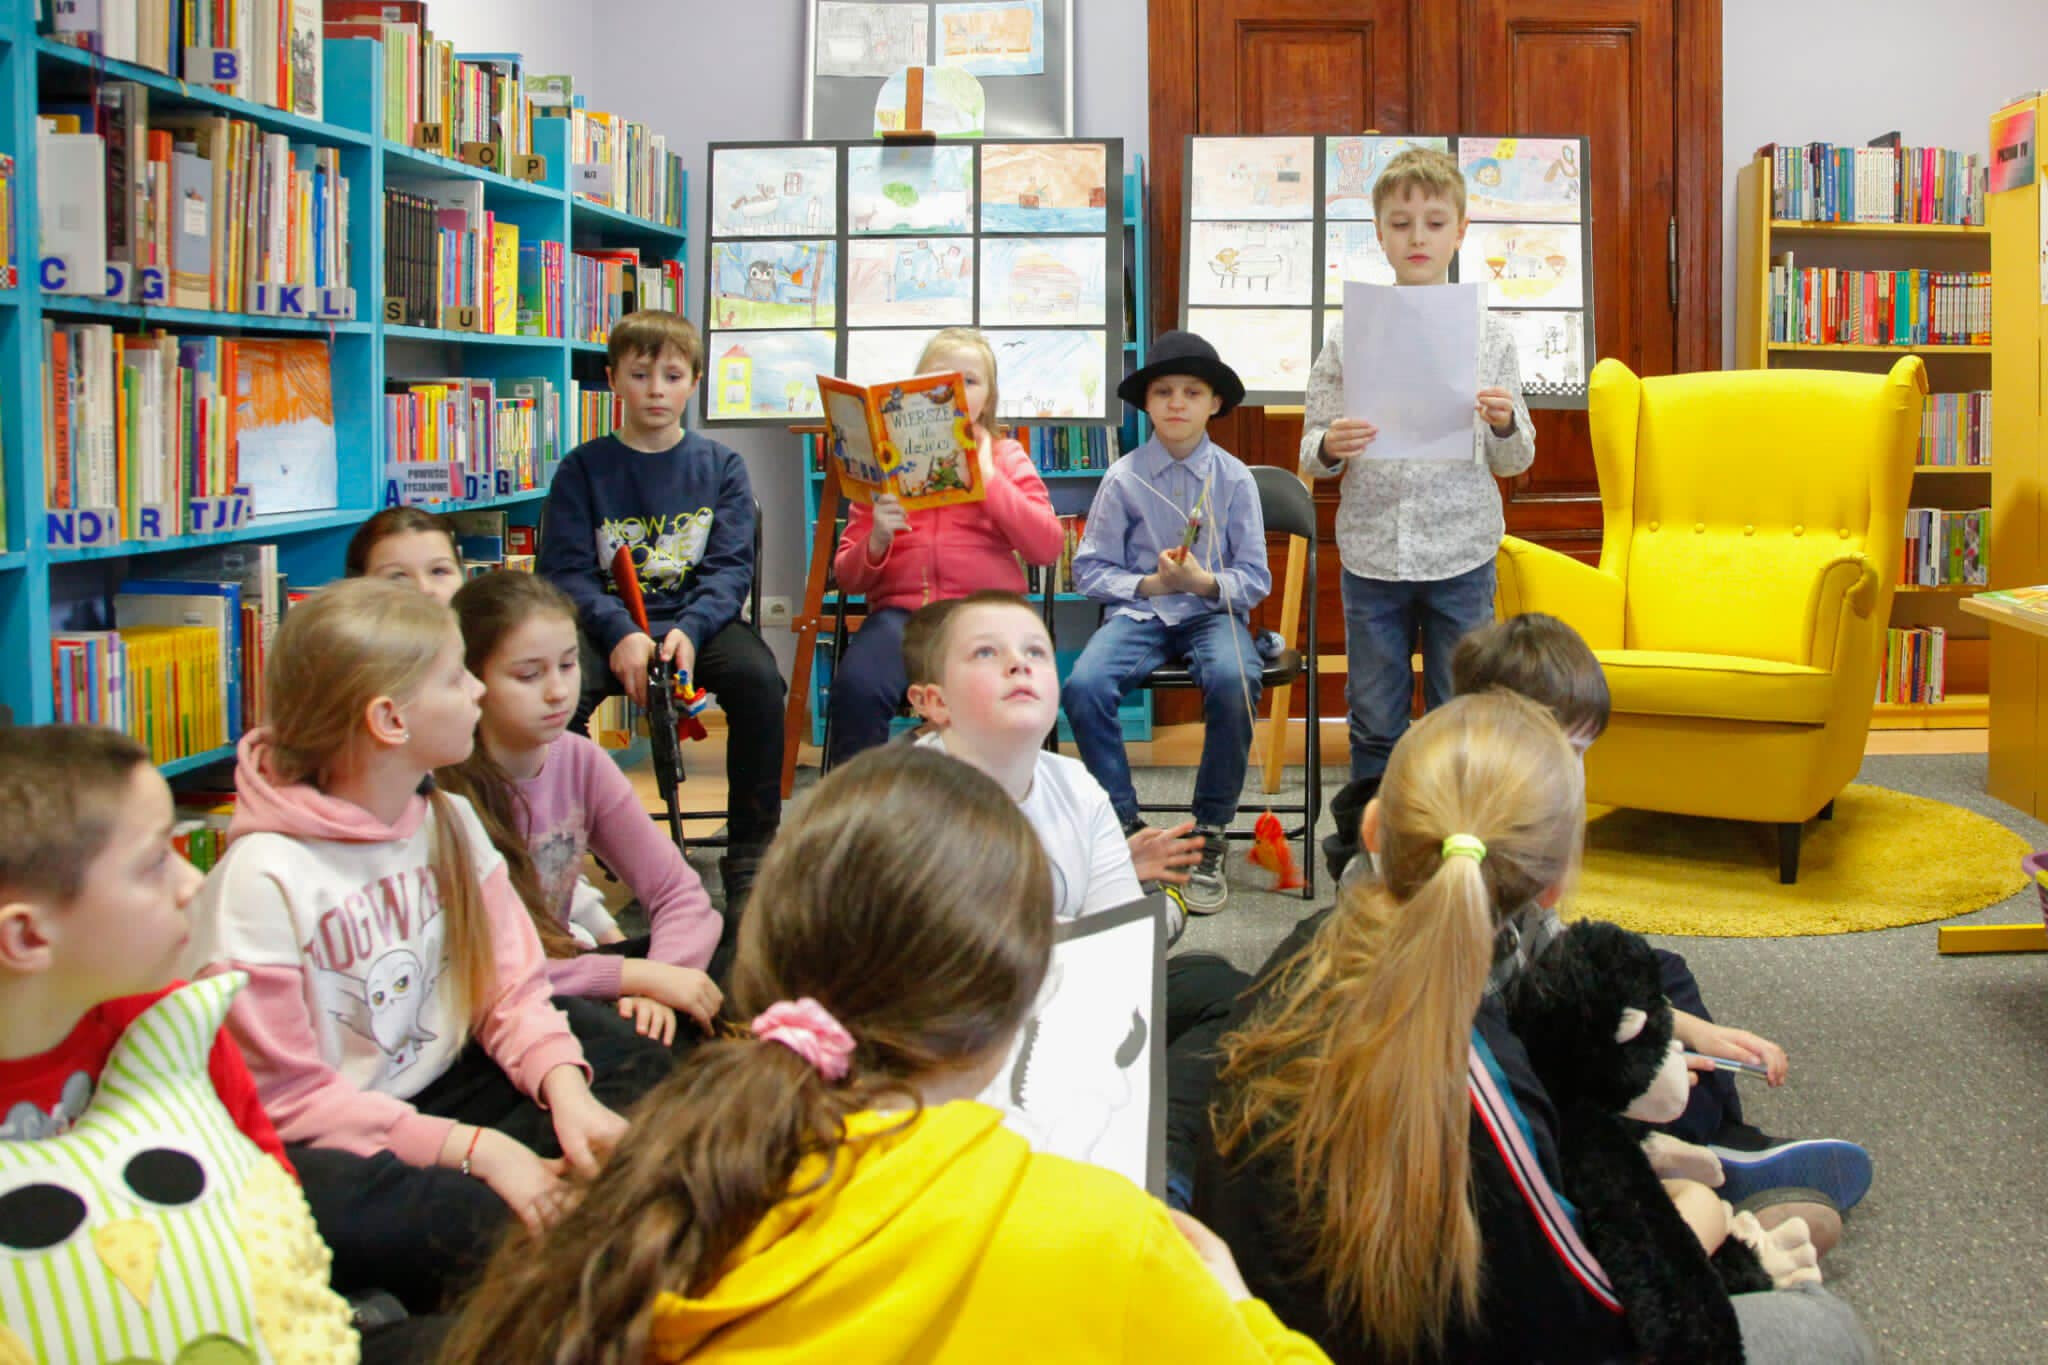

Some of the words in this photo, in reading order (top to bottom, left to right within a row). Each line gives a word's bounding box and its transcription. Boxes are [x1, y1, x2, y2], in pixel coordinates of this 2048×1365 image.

[213, 52, 238, 79] B
[422, 127, 440, 143] M
[479, 147, 494, 164] O
[526, 159, 539, 175] P
[40, 256, 66, 290] C
[143, 268, 164, 299] G
[257, 285, 265, 311] I
[280, 287, 302, 313] K
[386, 302, 401, 321] S
[459, 311, 473, 327] U
[890, 406, 952, 429] WIERSZE
[385, 479, 400, 507] A
[465, 475, 478, 501] D
[496, 469, 510, 495] G
[140, 508, 160, 537] R
[190, 502, 208, 529] T
[47, 513, 74, 545] N
